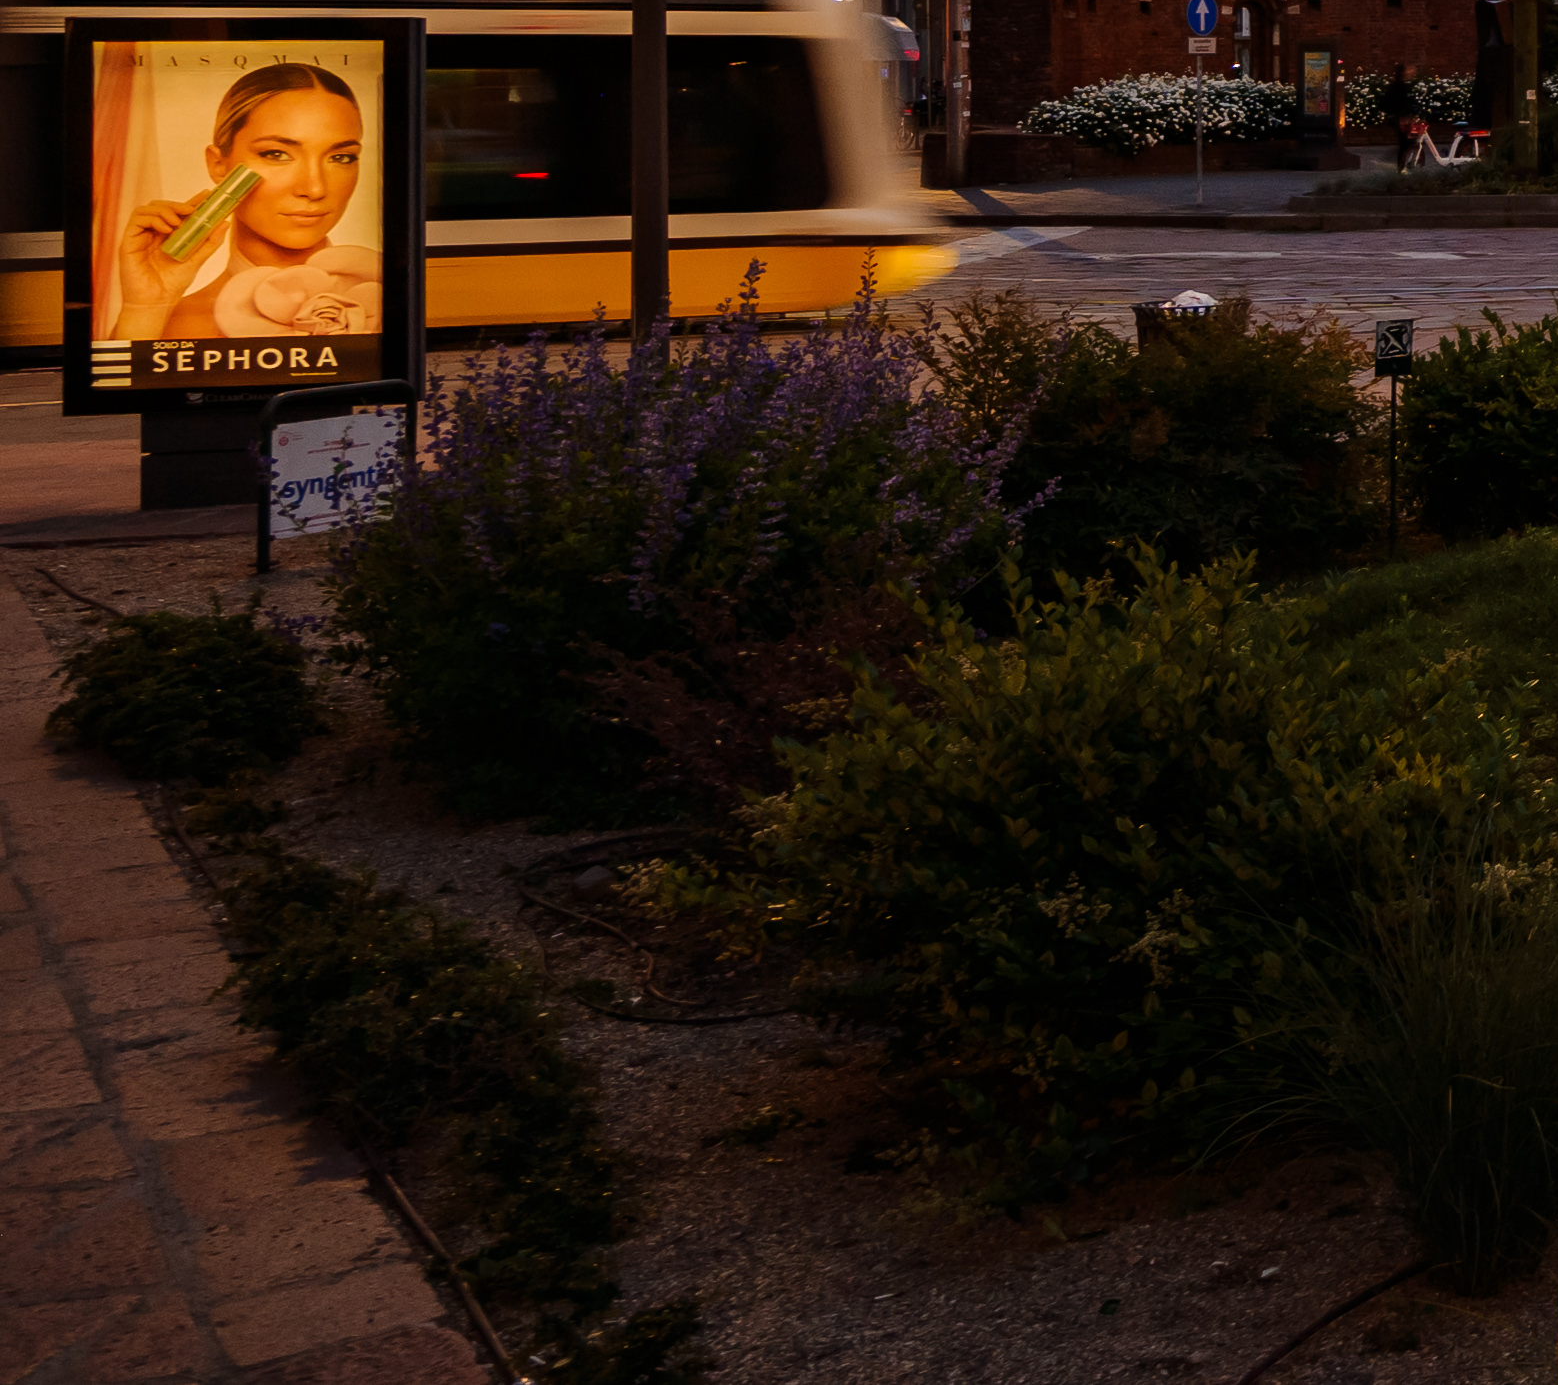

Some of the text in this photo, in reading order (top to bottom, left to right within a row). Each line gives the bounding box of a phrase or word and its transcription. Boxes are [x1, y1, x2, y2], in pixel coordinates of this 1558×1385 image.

[153, 341, 179, 350] SOLO
[152, 346, 339, 373] SEPHORA
[282, 465, 381, 505] syngent
